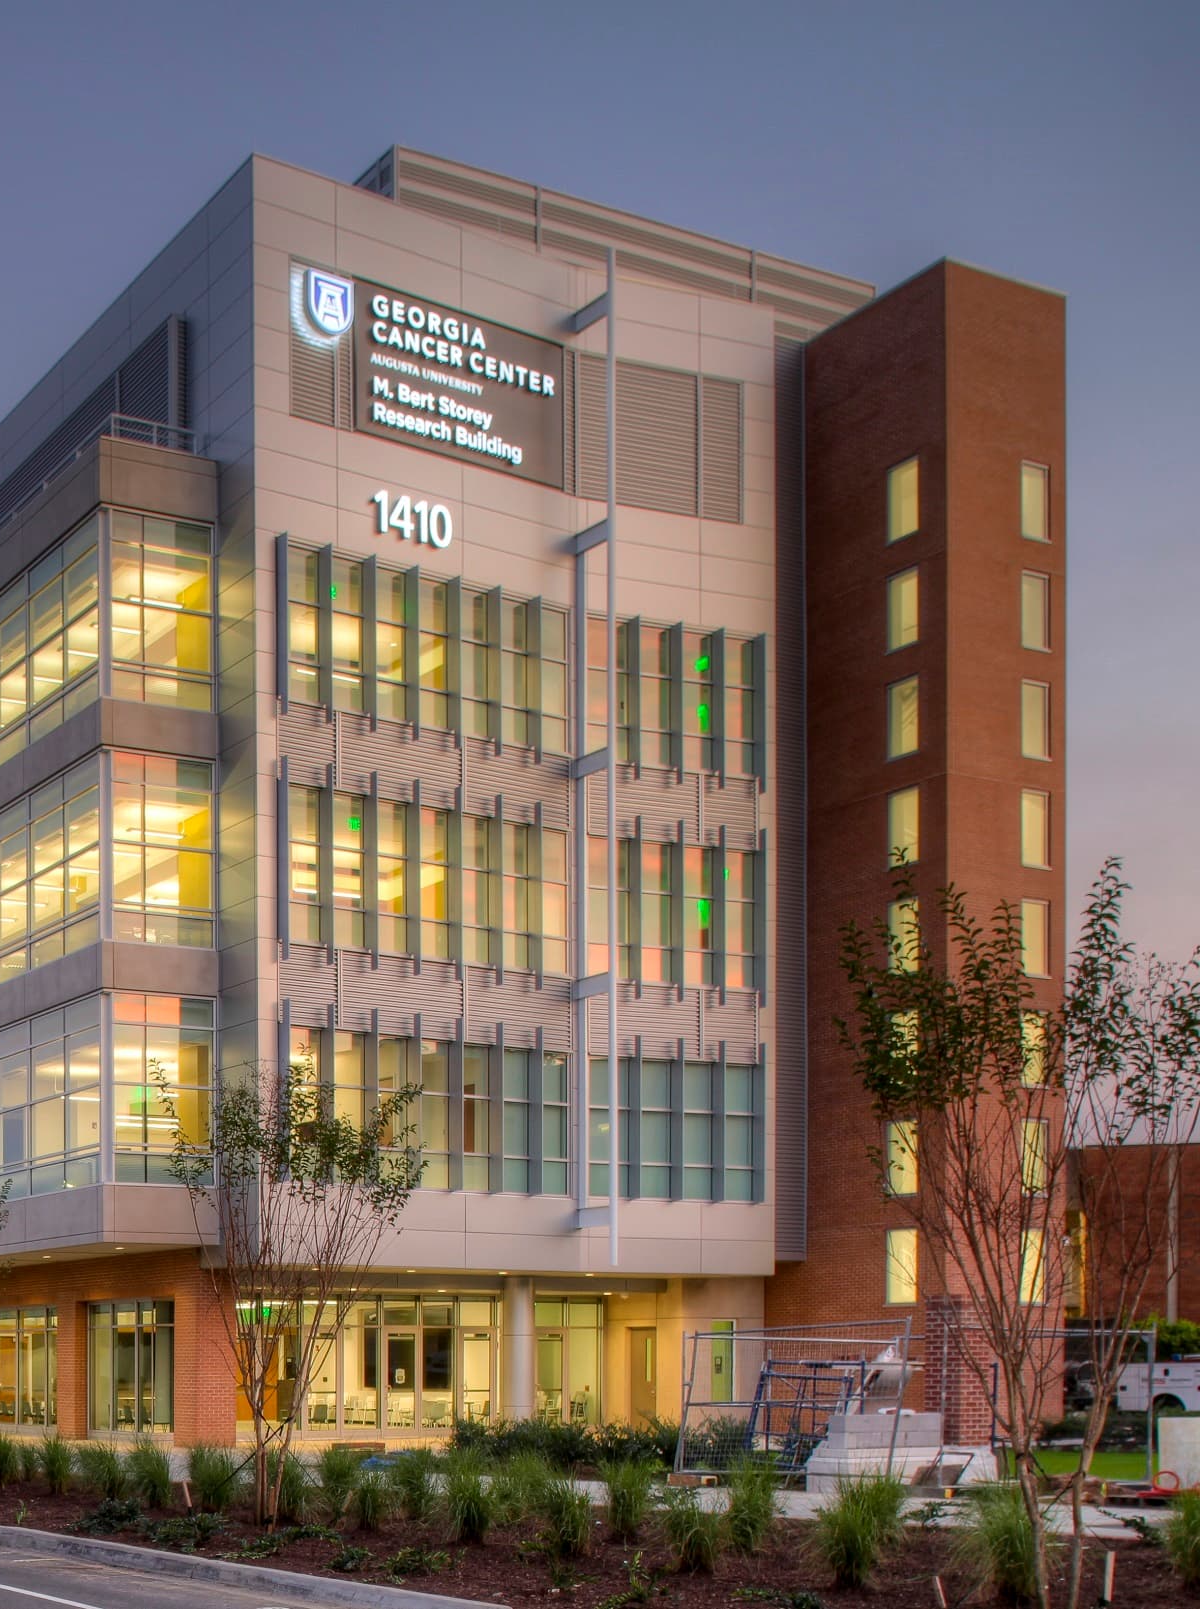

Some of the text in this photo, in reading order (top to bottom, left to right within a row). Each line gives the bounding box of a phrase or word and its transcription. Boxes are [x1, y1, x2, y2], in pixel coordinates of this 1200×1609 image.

[372, 294, 486, 350] GEORGIA
[370, 352, 483, 396] AUGUSTA UNIVERSITY
[372, 321, 555, 396] CANCER CENTER
[373, 376, 492, 430] M. Bert Storey
[373, 402, 522, 465] Research Building
[374, 490, 453, 548] 1410
